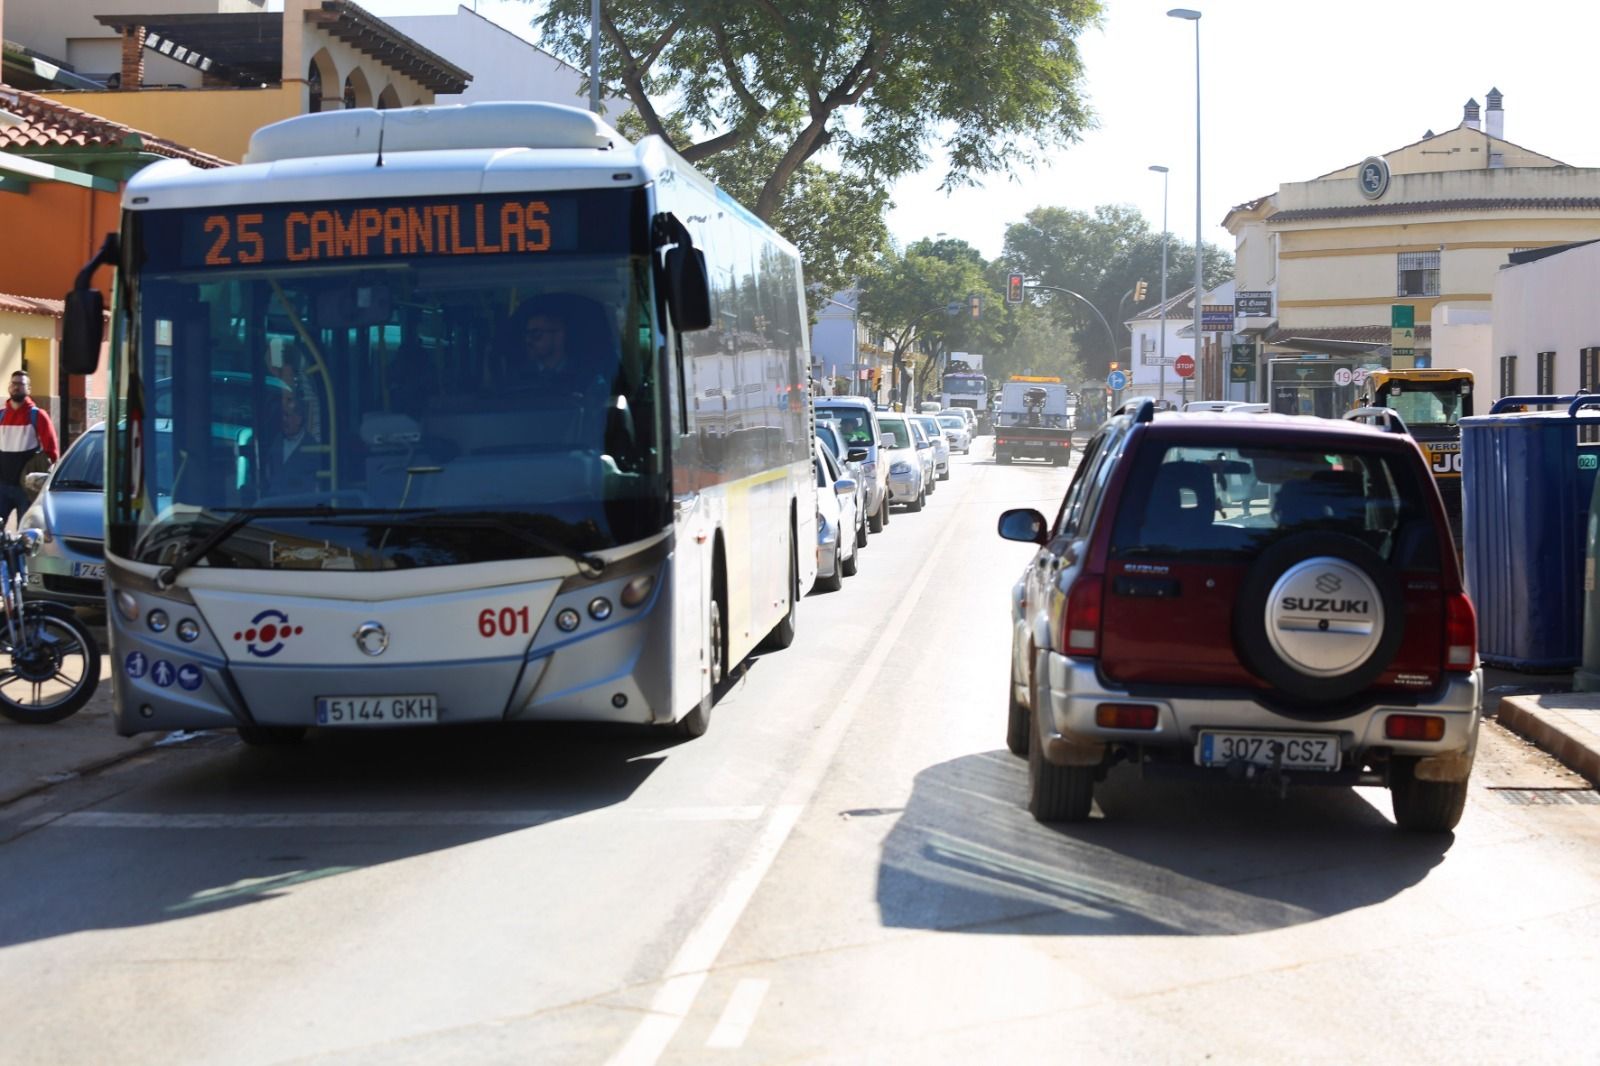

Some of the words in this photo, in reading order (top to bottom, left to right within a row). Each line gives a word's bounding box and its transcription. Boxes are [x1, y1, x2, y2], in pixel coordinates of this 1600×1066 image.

[204, 213, 264, 265] 25
[1336, 372, 1350, 383] 19
[1579, 457, 1595, 467] 020
[1282, 597, 1368, 614] SUZUKI
[478, 606, 529, 638] 601
[331, 701, 384, 721] 5144
[391, 699, 433, 719] GKH
[1286, 740, 1328, 763] CSZ
